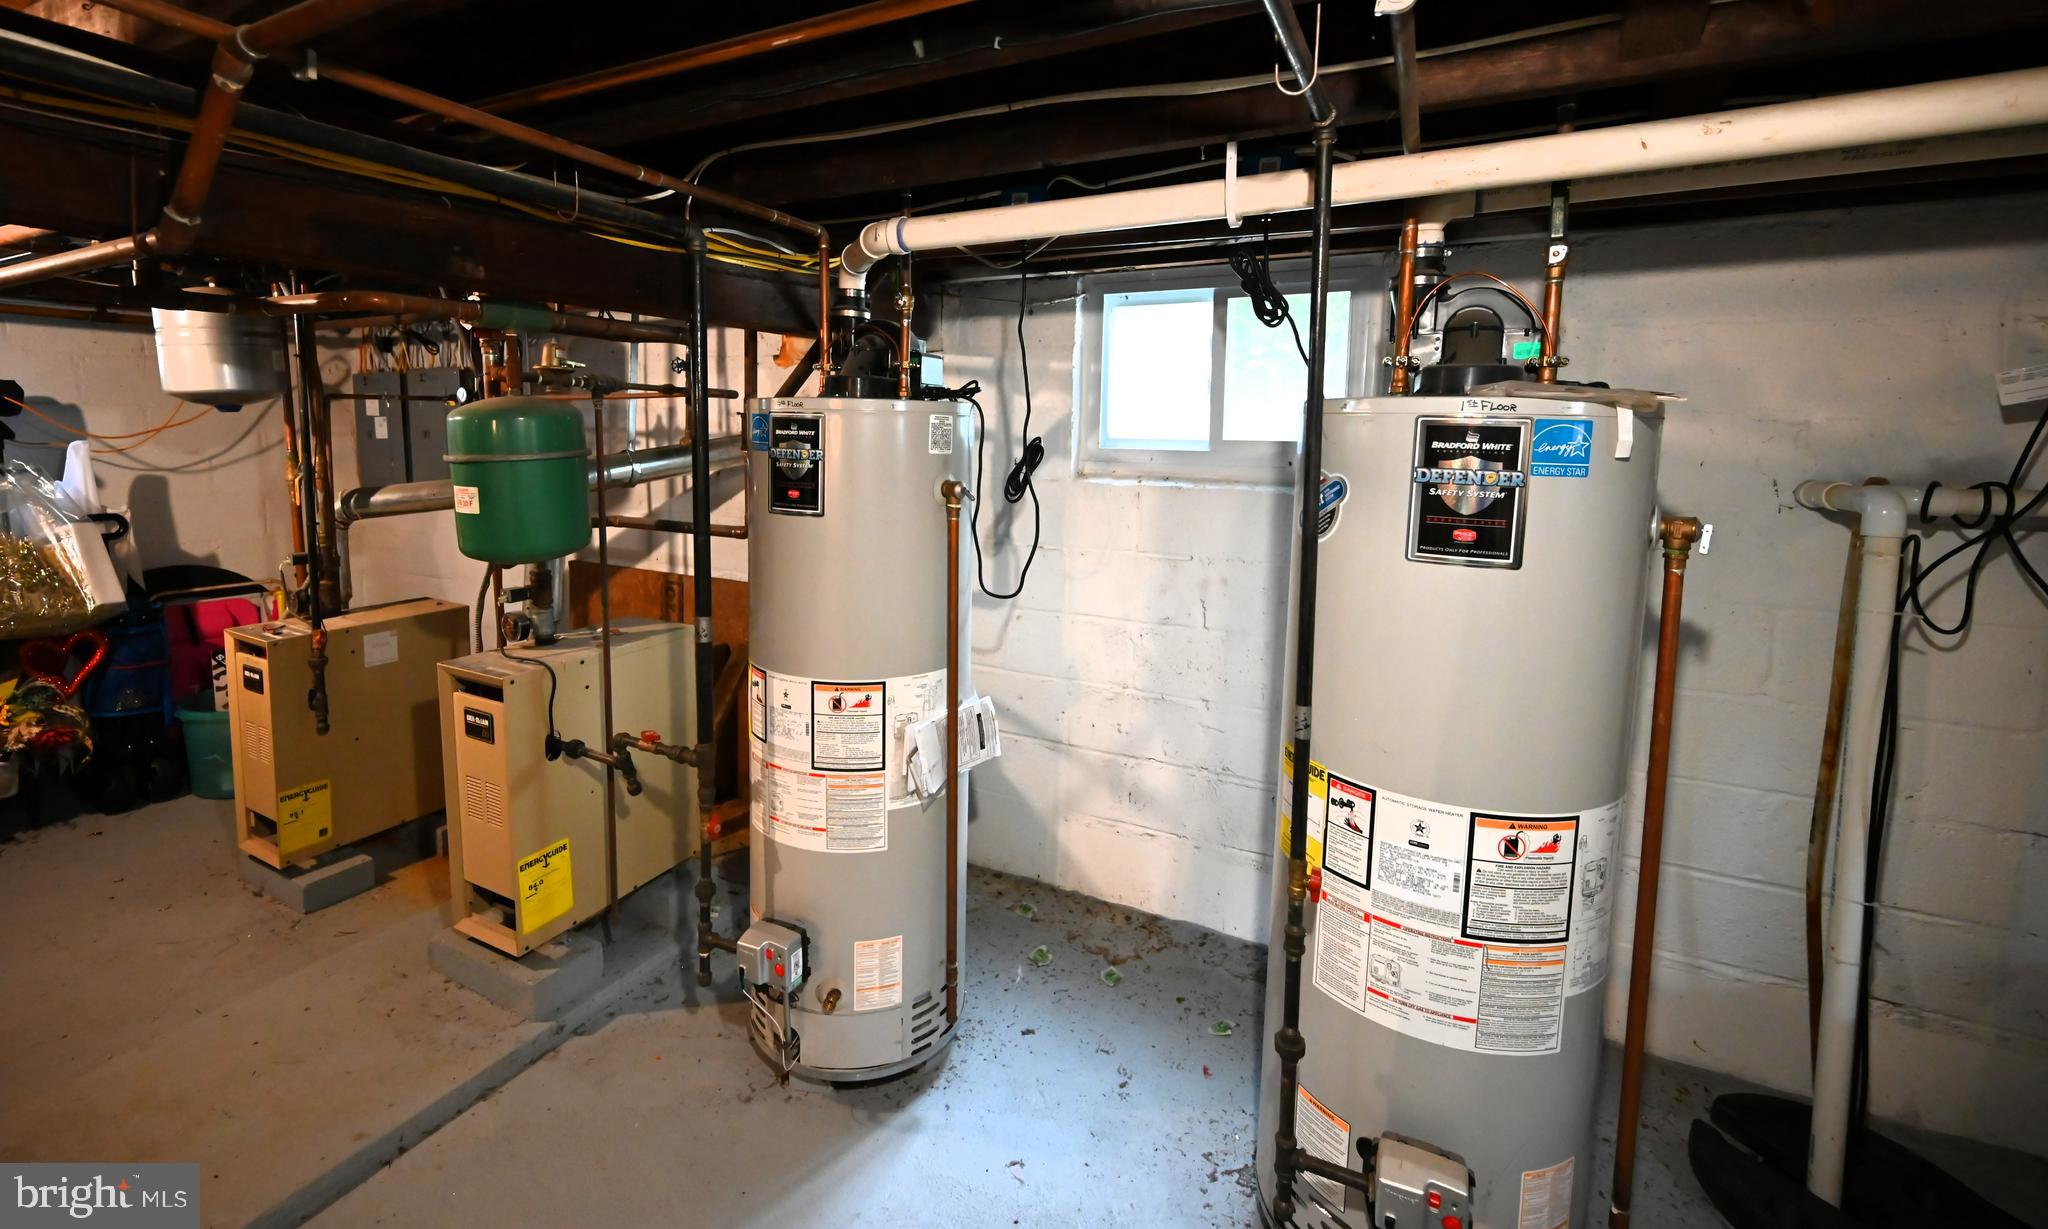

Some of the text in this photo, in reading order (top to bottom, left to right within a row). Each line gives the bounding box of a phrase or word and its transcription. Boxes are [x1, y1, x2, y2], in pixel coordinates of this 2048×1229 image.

[1431, 440, 1512, 451] BRADFORD WHITE
[1534, 442, 1573, 457] energy
[770, 448, 824, 461] DEFENDER
[1415, 467, 1525, 487] DEFENDER
[1532, 466, 1586, 476] ENERGY STAR
[1428, 488, 1506, 499] SAFETY SYSTEM
[520, 843, 568, 873] ENERGYGUIDE
[1312, 1100, 1334, 1120] WARNING
